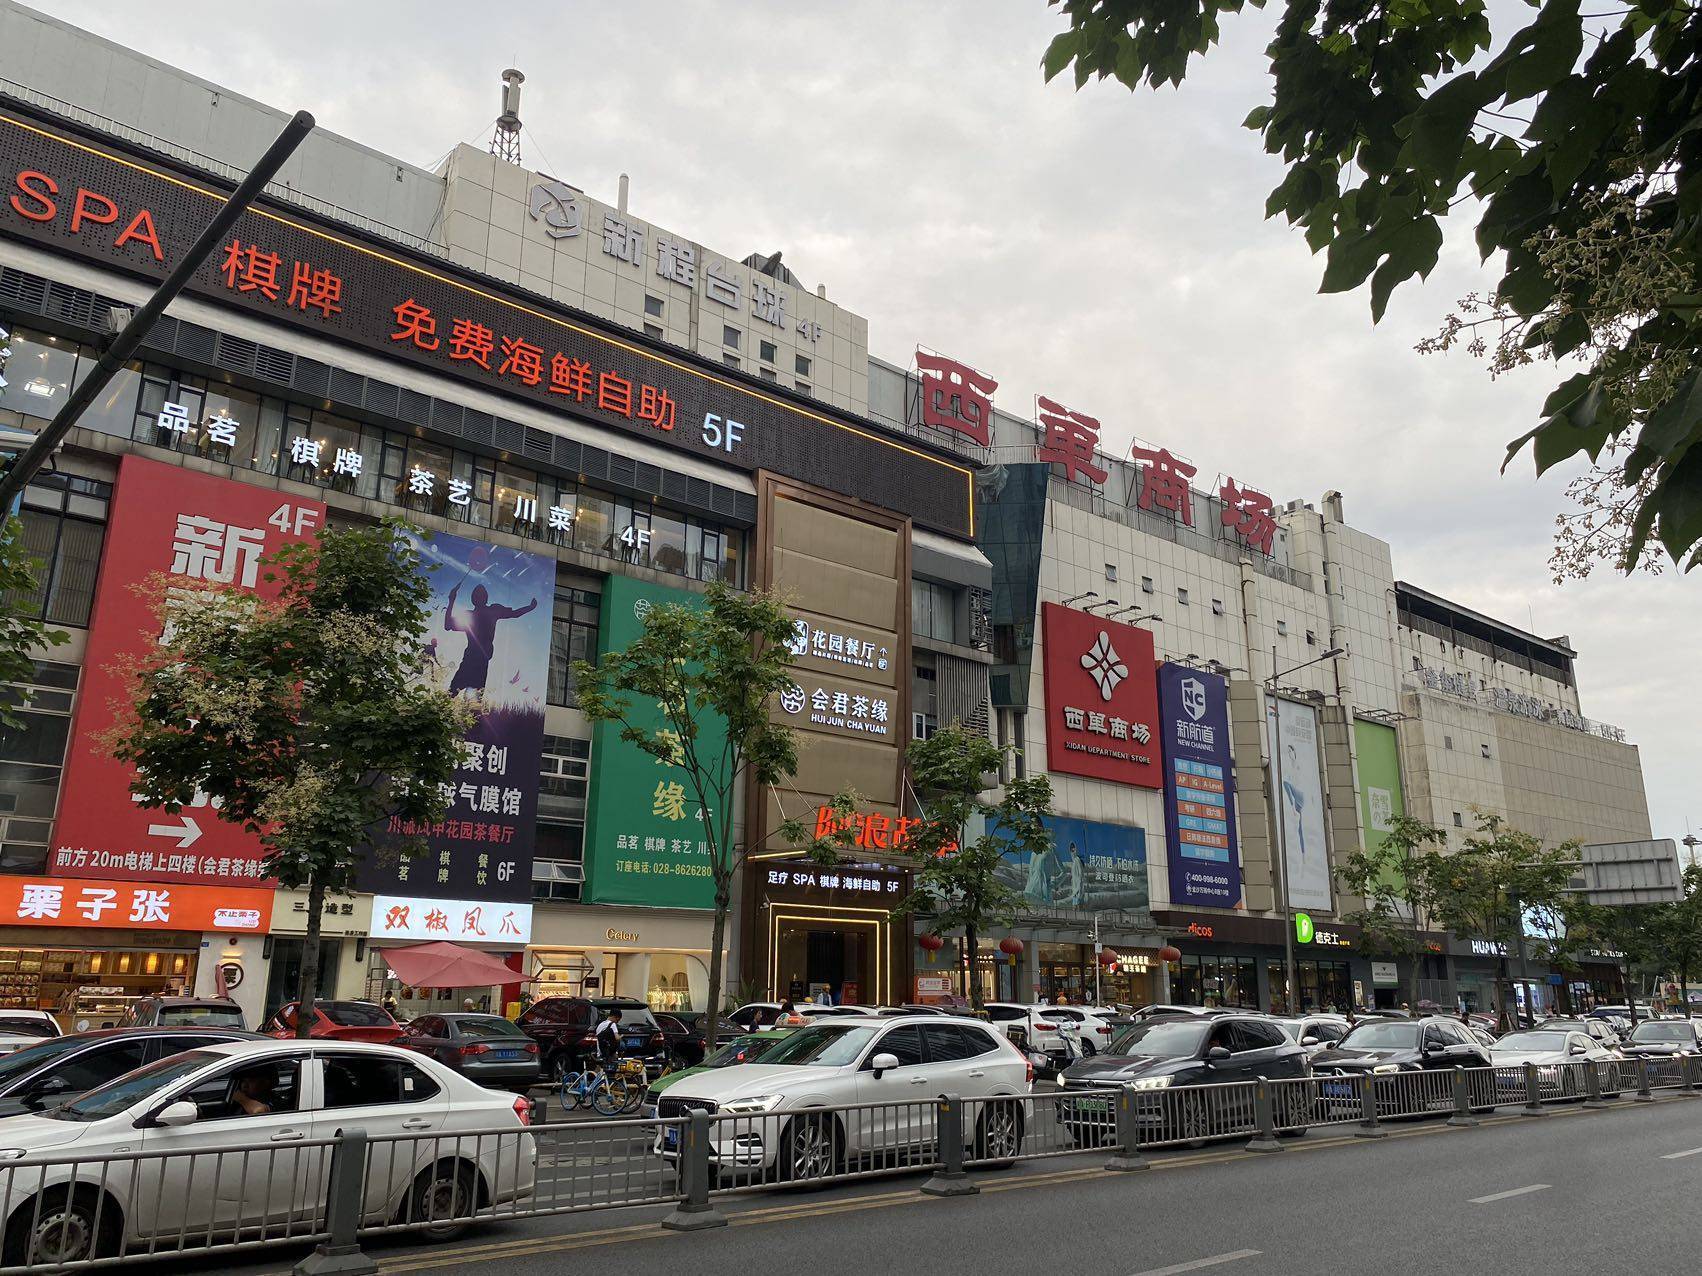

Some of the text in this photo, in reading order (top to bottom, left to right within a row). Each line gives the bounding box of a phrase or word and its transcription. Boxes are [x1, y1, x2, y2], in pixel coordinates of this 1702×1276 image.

[602, 211, 822, 343] 新程台球 4F
[10, 170, 745, 452] SPA 棋牌 免费海鲜自助 5F
[157, 401, 651, 549] 品茗 棋牌 茶艺 川菜 4F
[268, 503, 319, 537] 4F
[812, 629, 876, 660] 花园餐厅
[811, 687, 888, 722] 会君茶缘
[1176, 719, 1214, 745] 新航道
[1177, 738, 1215, 752] NEW CHANNEL
[1066, 740, 1151, 765] XIDAN DEPARTMENT STORE
[616, 834, 639, 850] 品茗
[644, 836, 666, 852] 棋牌
[671, 839, 692, 854] 茶艺
[437, 850, 451, 883] 棋牌
[476, 853, 488, 885] 餐饮
[497, 861, 516, 882] 6F
[768, 870, 899, 892] 足疗 SPA 棋牌 海鲜自助 5F
[17, 884, 170, 923] 栗子张
[1315, 931, 1339, 945] 德克士
